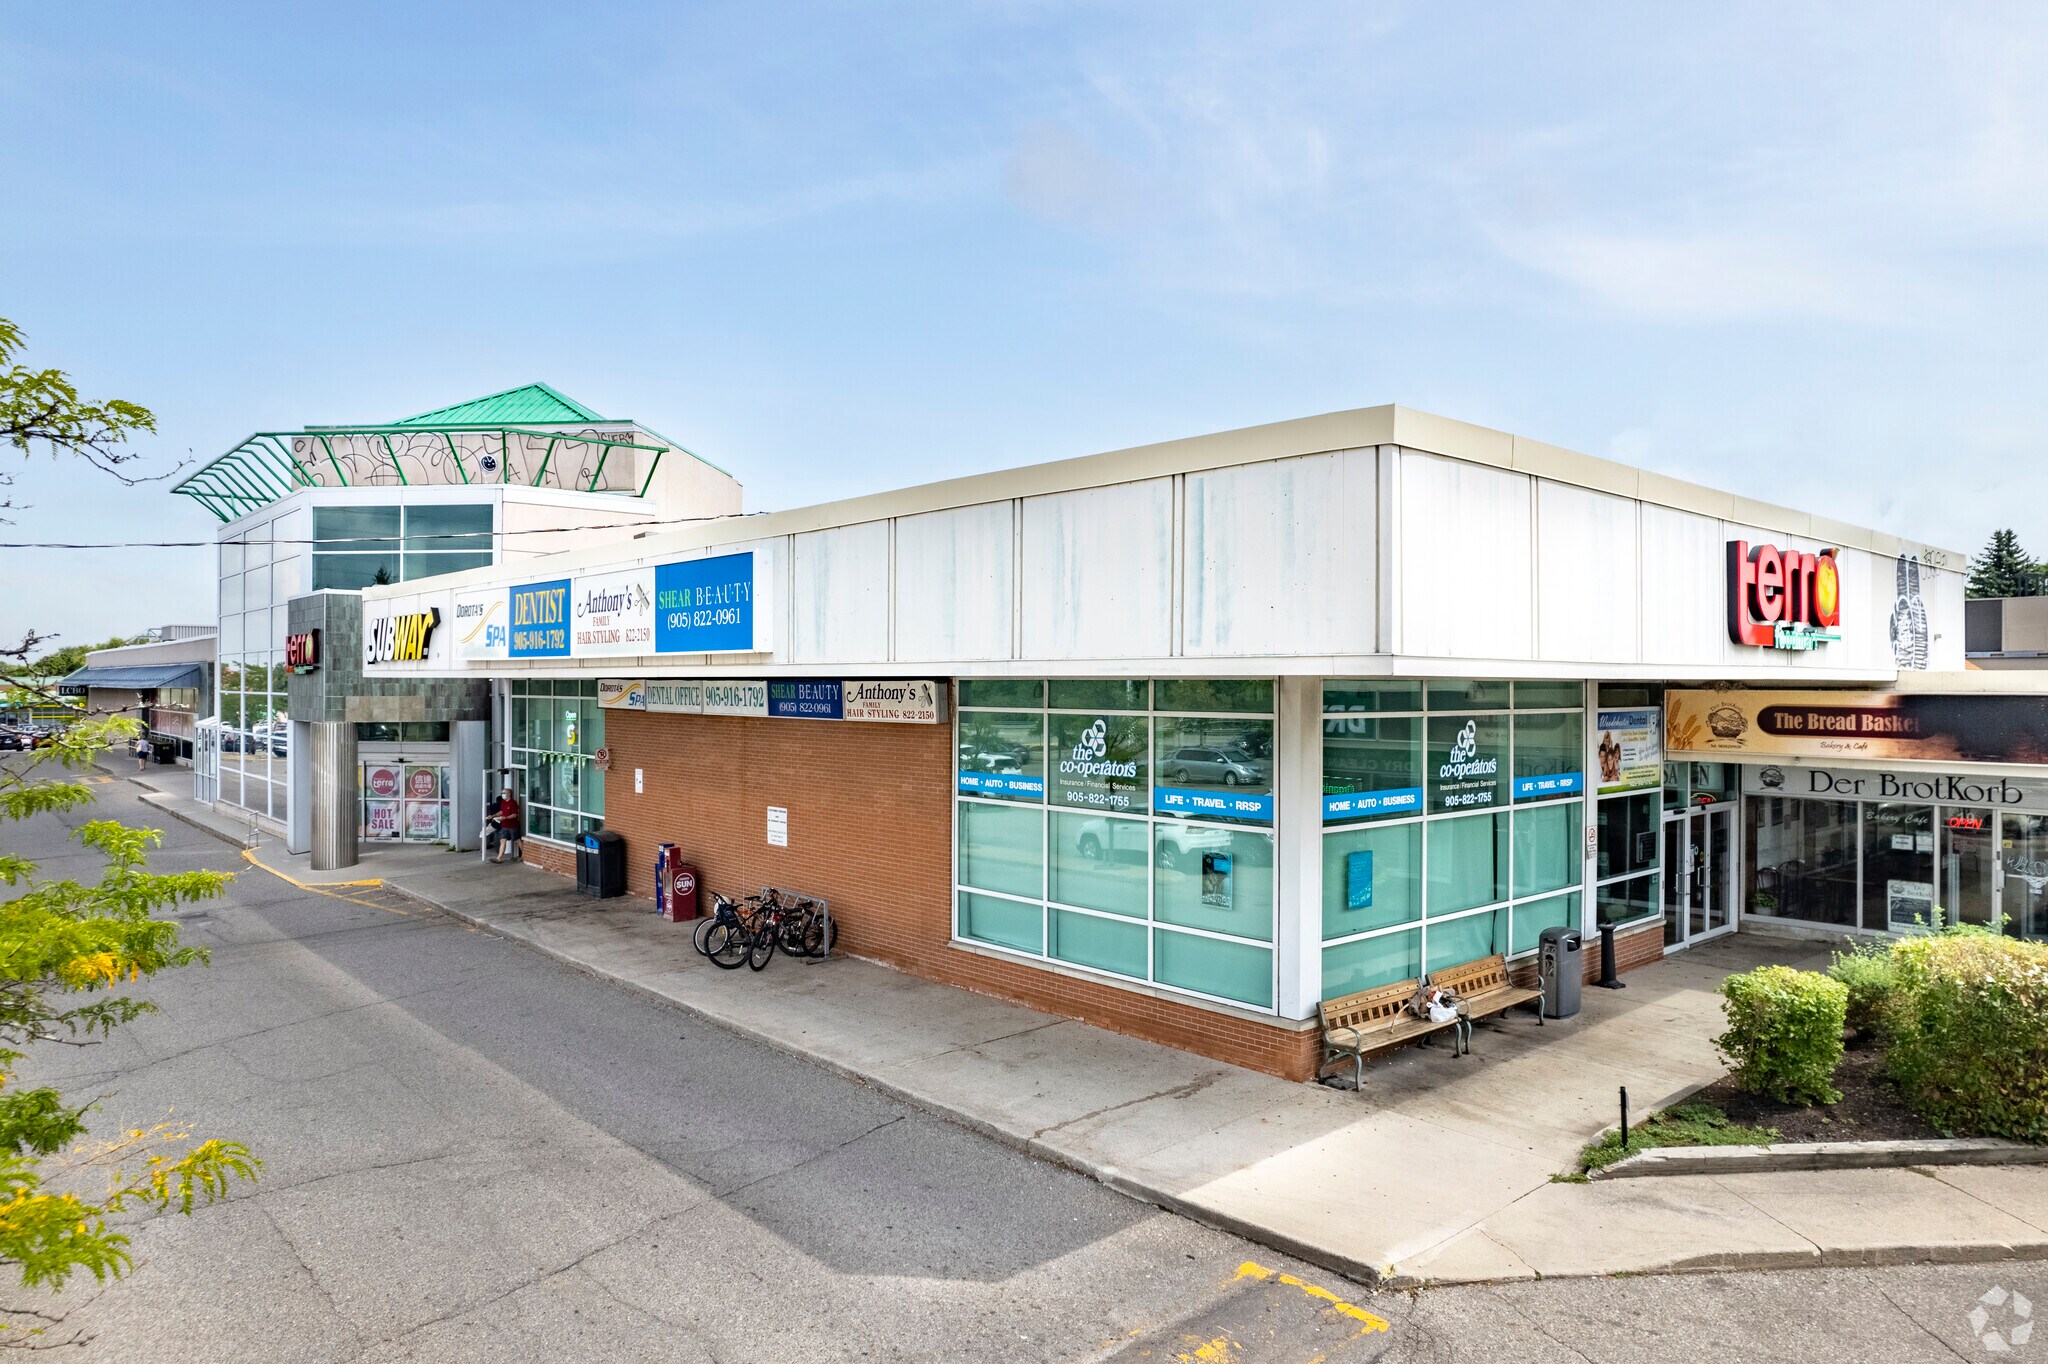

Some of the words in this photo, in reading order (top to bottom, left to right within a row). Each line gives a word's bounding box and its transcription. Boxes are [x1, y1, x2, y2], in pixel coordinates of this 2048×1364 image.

[514, 588, 566, 626] DENTIST
[577, 585, 632, 618] Anthony's
[659, 588, 691, 610] SHEAR
[593, 616, 611, 627] FAMILY
[667, 612, 692, 631] (905)
[693, 607, 742, 626] 822-0961
[366, 607, 441, 664] SUBWAY
[485, 624, 506, 647] SPA
[514, 629, 565, 650] 905-916-1792
[577, 631, 592, 645] HAIR
[592, 628, 621, 644] STYLING
[61, 686, 86, 695] LCBO
[628, 691, 645, 706] SPA
[647, 687, 674, 705] DENTAL
[675, 686, 700, 706] OFFICE
[705, 687, 764, 708] 905-916-1792
[771, 684, 796, 699] SHEAR
[846, 683, 916, 703] Anthony's
[779, 702, 797, 712] (905)
[799, 702, 831, 713] 822-0961
[846, 708, 864, 718] HAIR
[867, 710, 899, 719] STYLING
[902, 711, 934, 720] 822-2150
[1628, 714, 1647, 726] Dental
[1775, 712, 1803, 729] The
[1807, 713, 1857, 731] Bread
[1072, 743, 1093, 760] the
[1450, 745, 1466, 763] the
[960, 776, 979, 786] HOME
[985, 779, 1003, 788] AUTO
[1009, 781, 1043, 792] BUSINESS
[1060, 779, 1084, 787] Insurance
[1087, 780, 1111, 789] Financial
[1112, 783, 1136, 791] Services
[1440, 782, 1460, 791] Insurance
[1462, 781, 1479, 789] Financial
[1522, 782, 1534, 791] LIFE
[1538, 780, 1556, 789] TRAVEL
[1808, 770, 1865, 794] Der
[1879, 773, 2023, 804] BrotKorb
[1067, 791, 1130, 806] 905-822-1755
[1165, 795, 1183, 805] LIFE
[1192, 797, 1226, 809] TRAVEL
[1236, 800, 1262, 812] RRSP
[1329, 801, 1351, 812] HOME
[1357, 798, 1377, 809] AUTO
[1383, 794, 1415, 806] BUSINESS
[1445, 792, 1492, 807] 905-822-1755
[374, 808, 393, 818] HOT
[1866, 811, 1900, 826] Bakery
[371, 819, 394, 829] SALE
[1949, 816, 1982, 829] OPEN
[676, 880, 692, 888] SUN
